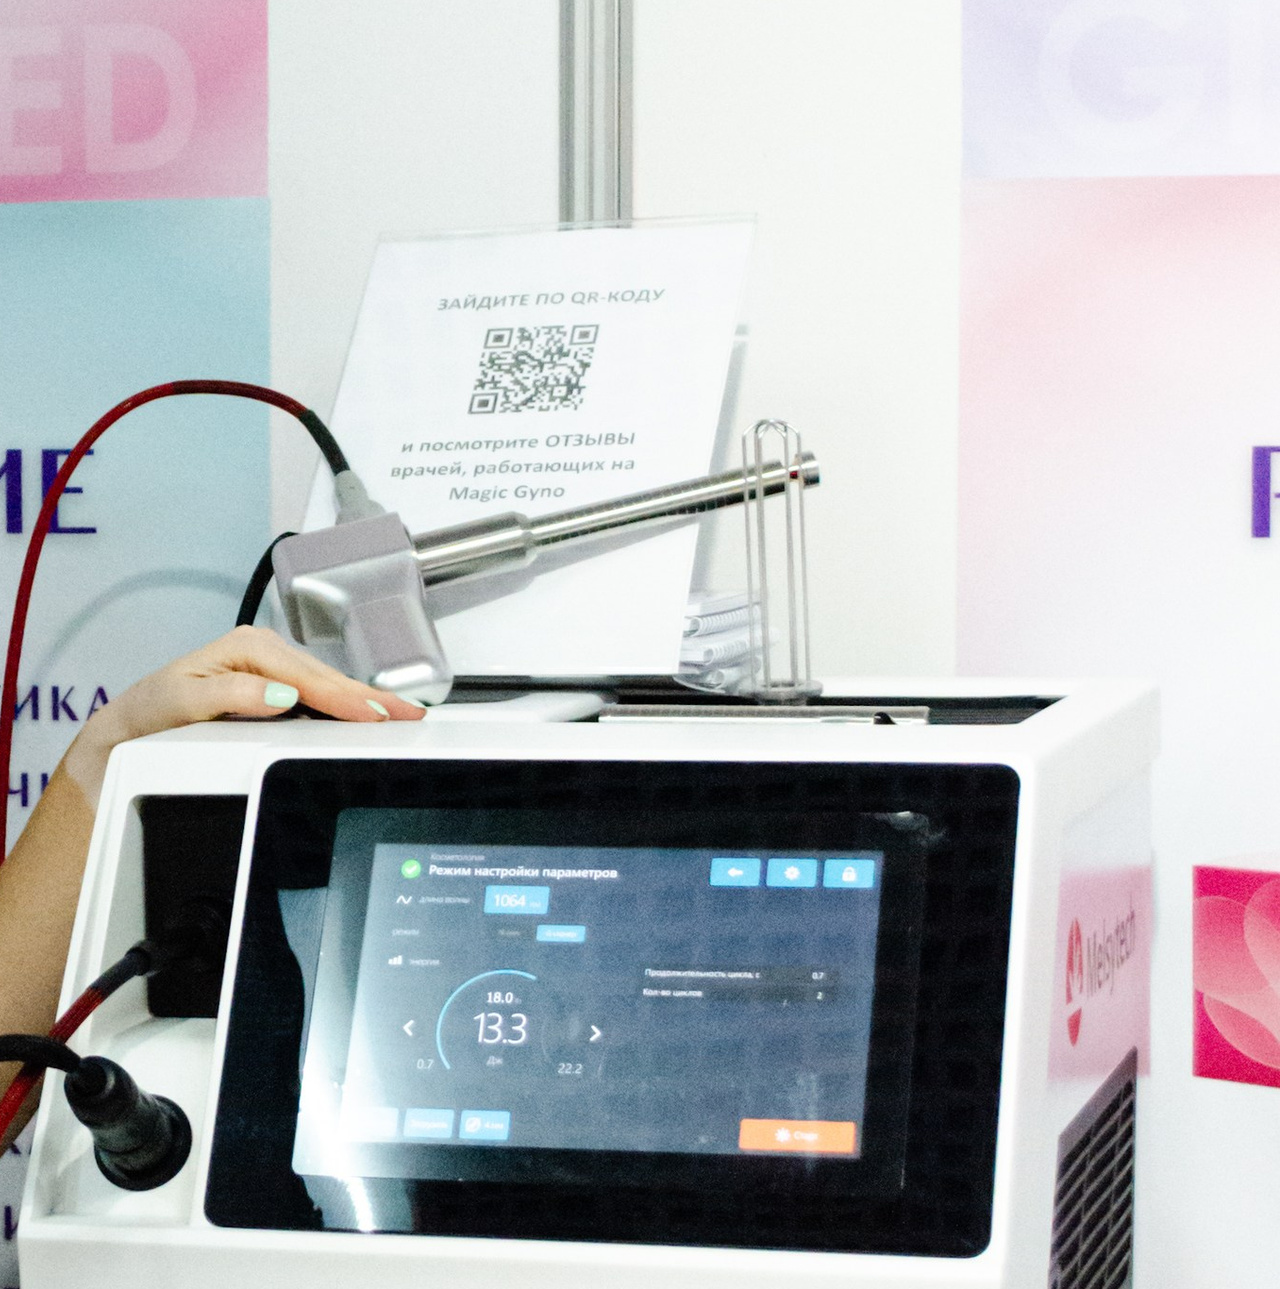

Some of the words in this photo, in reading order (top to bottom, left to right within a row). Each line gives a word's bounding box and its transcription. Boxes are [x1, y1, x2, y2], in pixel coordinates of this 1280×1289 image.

[438, 292, 530, 312] ЗАЙДИТЕ
[535, 291, 566, 307] ПО
[570, 288, 665, 307] QR-КОДУ
[401, 441, 414, 454] и
[419, 438, 539, 456] посмотрите
[545, 432, 636, 449] ОТЗЫВЫ
[391, 460, 467, 479] врачей,
[473, 457, 605, 478] работающих
[611, 457, 635, 471] на
[449, 485, 508, 503] Magic
[513, 484, 565, 503] Gyno
[429, 864, 471, 877] Режим
[474, 866, 539, 880] настройки
[542, 868, 618, 881] параметров
[494, 893, 527, 908] 1064
[487, 992, 514, 1004] 18.0
[473, 1012, 528, 1045] 13.3
[416, 1058, 435, 1070] 0.7
[557, 1063, 583, 1075] 22.2
